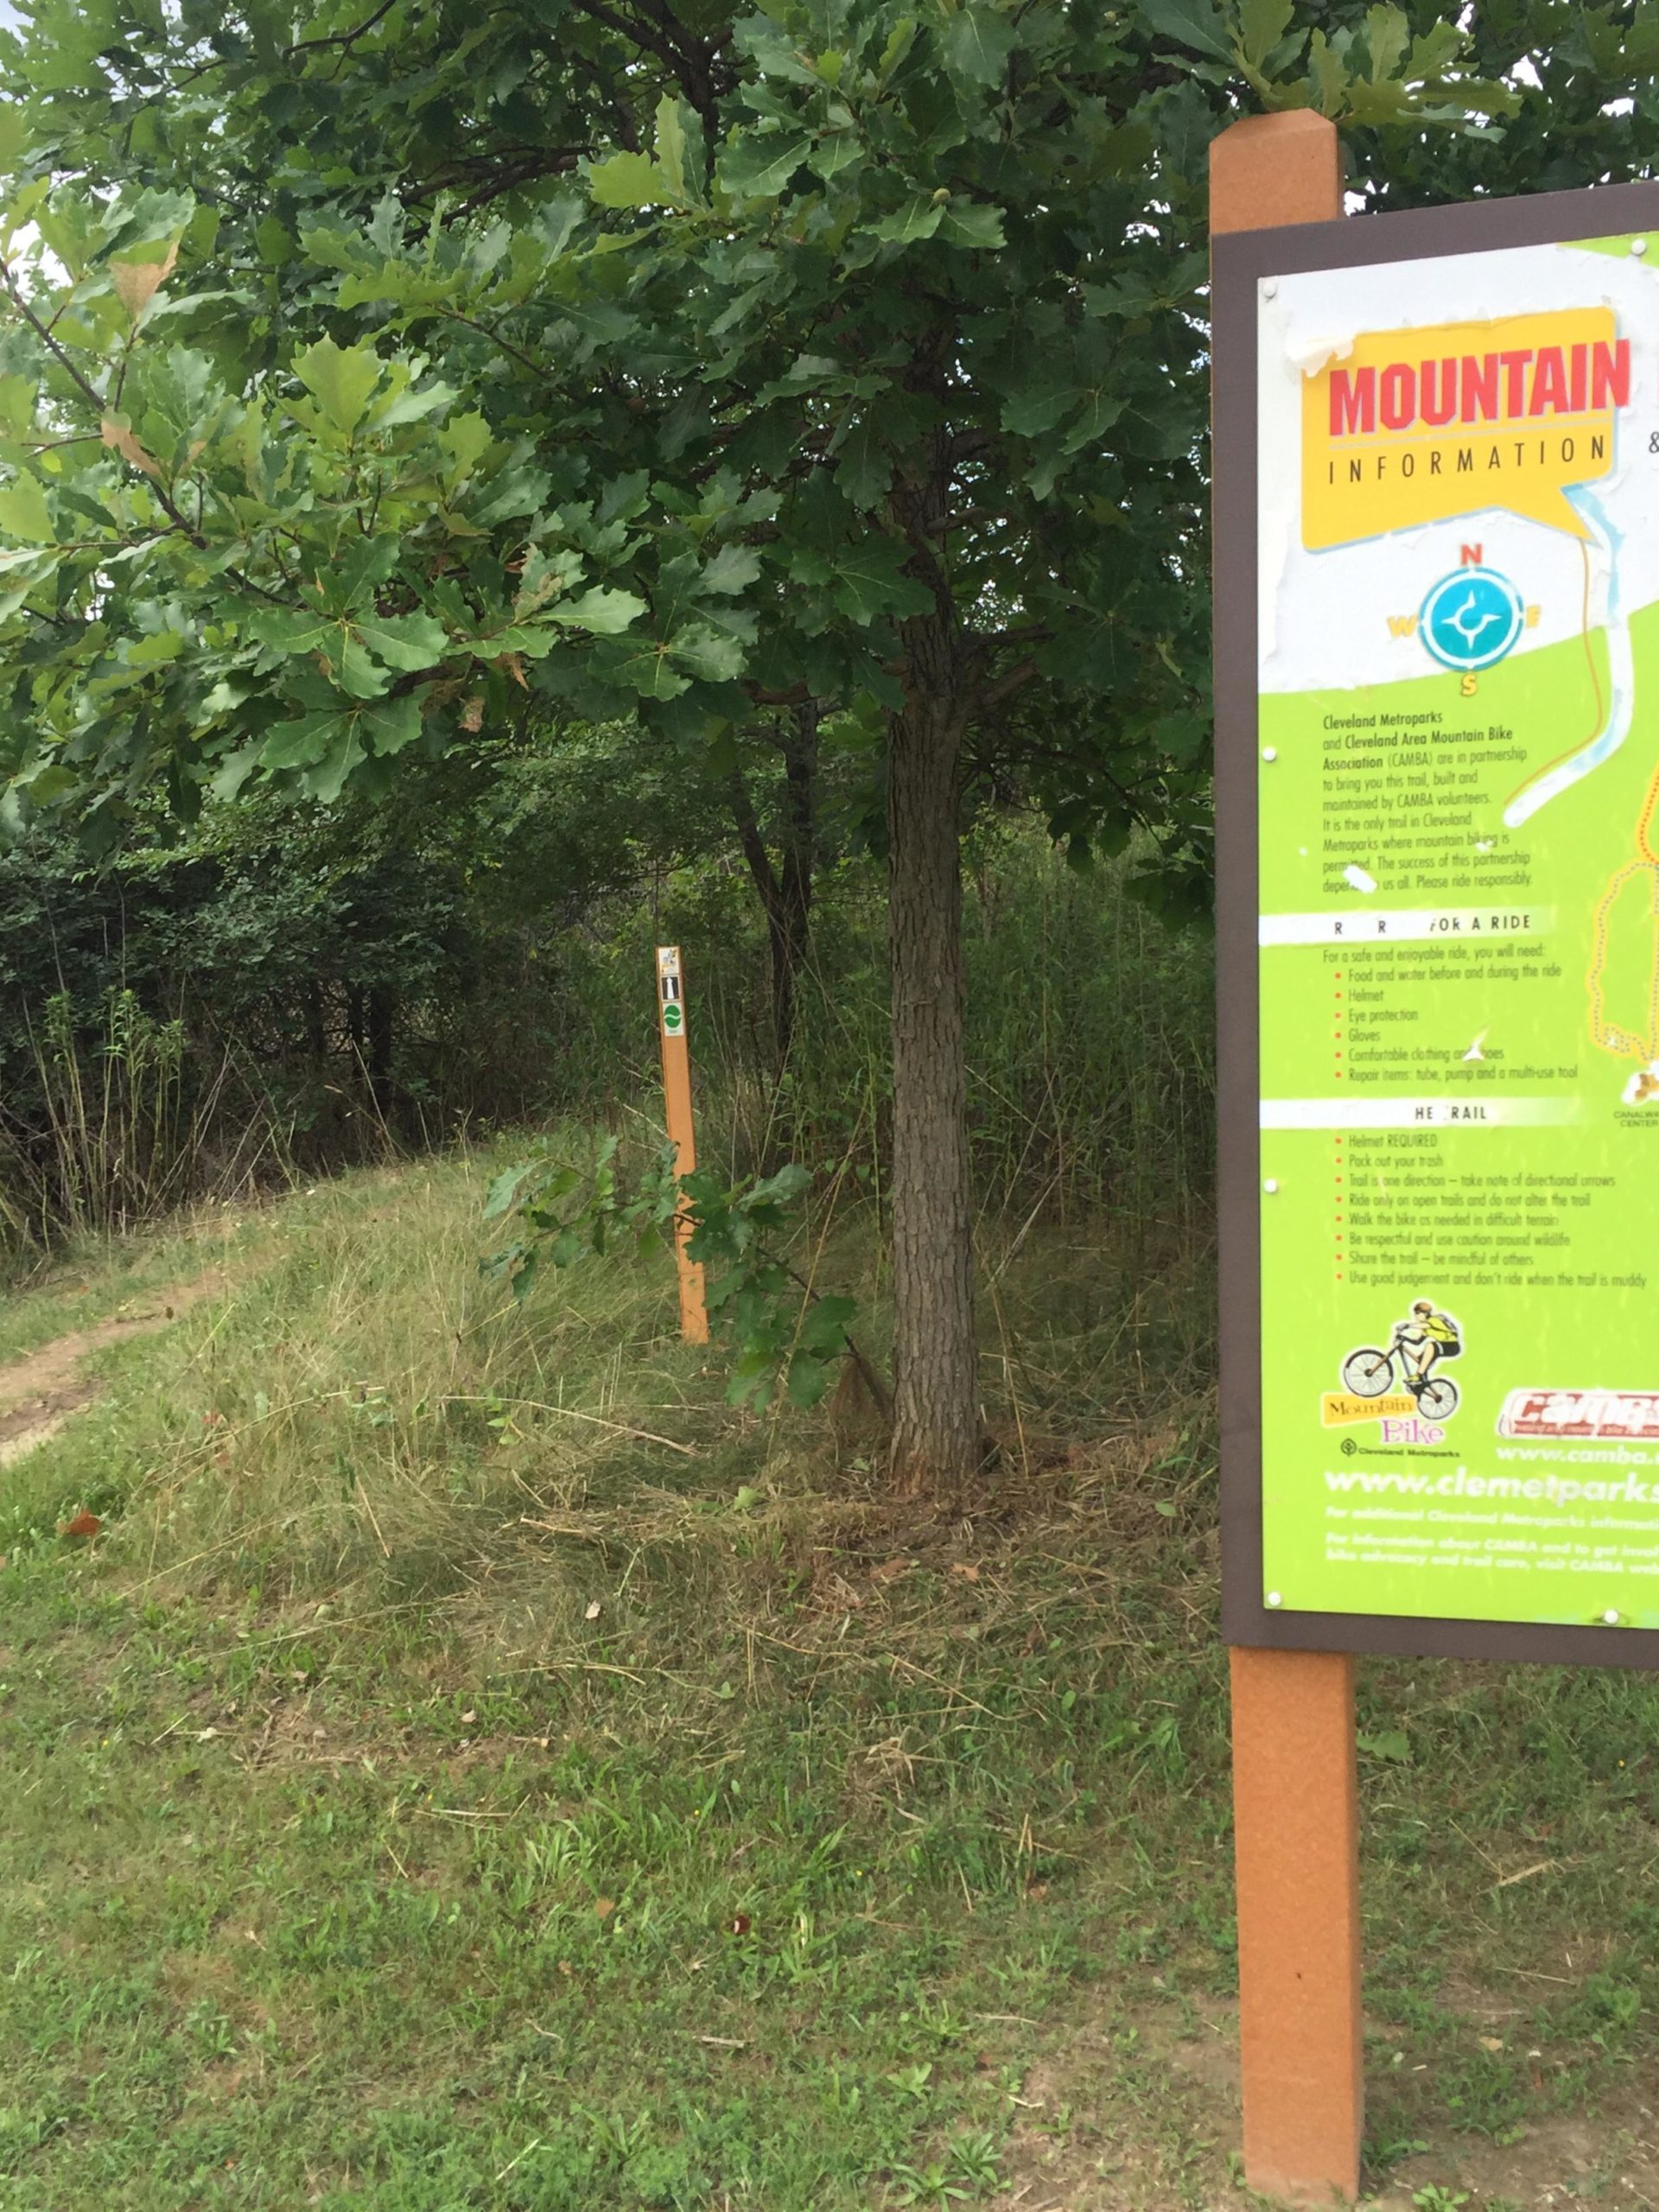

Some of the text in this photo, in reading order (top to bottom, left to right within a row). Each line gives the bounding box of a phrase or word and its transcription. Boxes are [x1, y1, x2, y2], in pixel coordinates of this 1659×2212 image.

[1329, 339, 1630, 436] MOUNTAIN
[1329, 435, 1604, 484] INFORMATION
[1460, 543, 1483, 566] N
[1323, 711, 1442, 729] Cleveland Metroparks
[1323, 726, 1512, 751] and Cleveland Area Mountain Bike
[1323, 747, 1527, 770] Association (CAMBA) are in partnership
[1323, 770, 1478, 792] to bring you this trail, built and
[1323, 792, 1492, 810] maintained by CAMBA volunteers.
[1323, 812, 1471, 831] It is the only trail in Cleveland
[1323, 837, 1378, 852] Metroparks
[1383, 835, 1412, 849] where
[1416, 833, 1464, 847] mountain
[1502, 833, 1510, 843] is
[1377, 850, 1530, 869] The success of this partnership
[1383, 879, 1394, 890] us
[1397, 876, 1412, 889] all.
[1416, 874, 1448, 888] Please
[1452, 873, 1471, 887] ride
[1474, 871, 1532, 887] responsibly.
[1472, 915, 1530, 930] A RIDE
[1323, 943, 1545, 963] For a safe and enjoyable ride, you will need:
[1349, 962, 1561, 982] Food and water before and during the ride
[1349, 989, 1383, 1001] Helmet
[1349, 1008, 1418, 1024] Eye protection
[1349, 1029, 1380, 1041] Gloves
[1349, 1047, 1450, 1063] Comfortable clothing
[1350, 1065, 1578, 1084] Repair items: tube, pump and a multi-use tool
[1445, 1106, 1486, 1120] RAIL
[1349, 1134, 1438, 1147] Helmet REQUIRED
[1349, 1154, 1443, 1169] Pack out your trash
[1350, 1173, 1616, 1186] Trail direction take note of directional arrows
[1350, 1193, 1591, 1209] Ride only on open trails and do not alter the trail
[1350, 1212, 1559, 1226] Walk the bike as needed in difficult terrain
[1350, 1231, 1571, 1247] Be respectful and use caution around wildlife
[1350, 1251, 1533, 1265] Share the trail be mindful of others
[1330, 1398, 1413, 1416] Mountain
[1382, 1419, 1443, 1444] Bike
